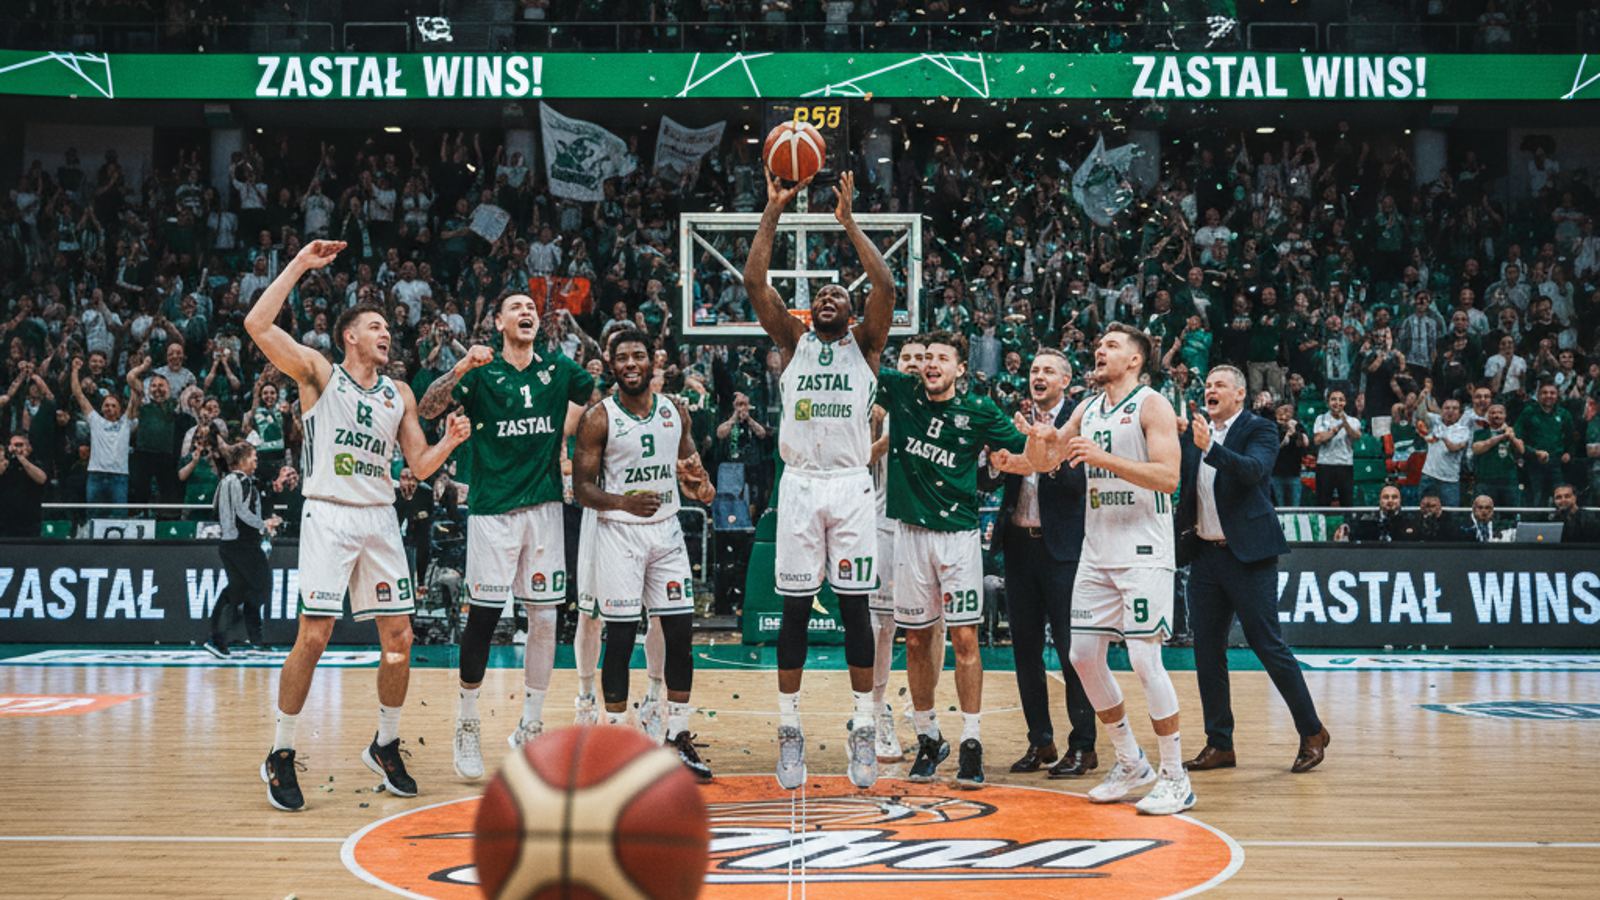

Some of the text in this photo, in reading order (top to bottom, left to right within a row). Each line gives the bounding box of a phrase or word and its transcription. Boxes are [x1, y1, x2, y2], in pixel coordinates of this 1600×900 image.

[255, 55, 543, 97] ZASTAŁ WINS!
[1132, 55, 1427, 98] ZASTAL WINS!
[796, 373, 853, 392] ZASTAL
[496, 415, 555, 437] ZASTAL
[904, 436, 957, 469] ZASTAL
[854, 556, 873, 582] 17
[1467, 571, 1600, 624] WINS
